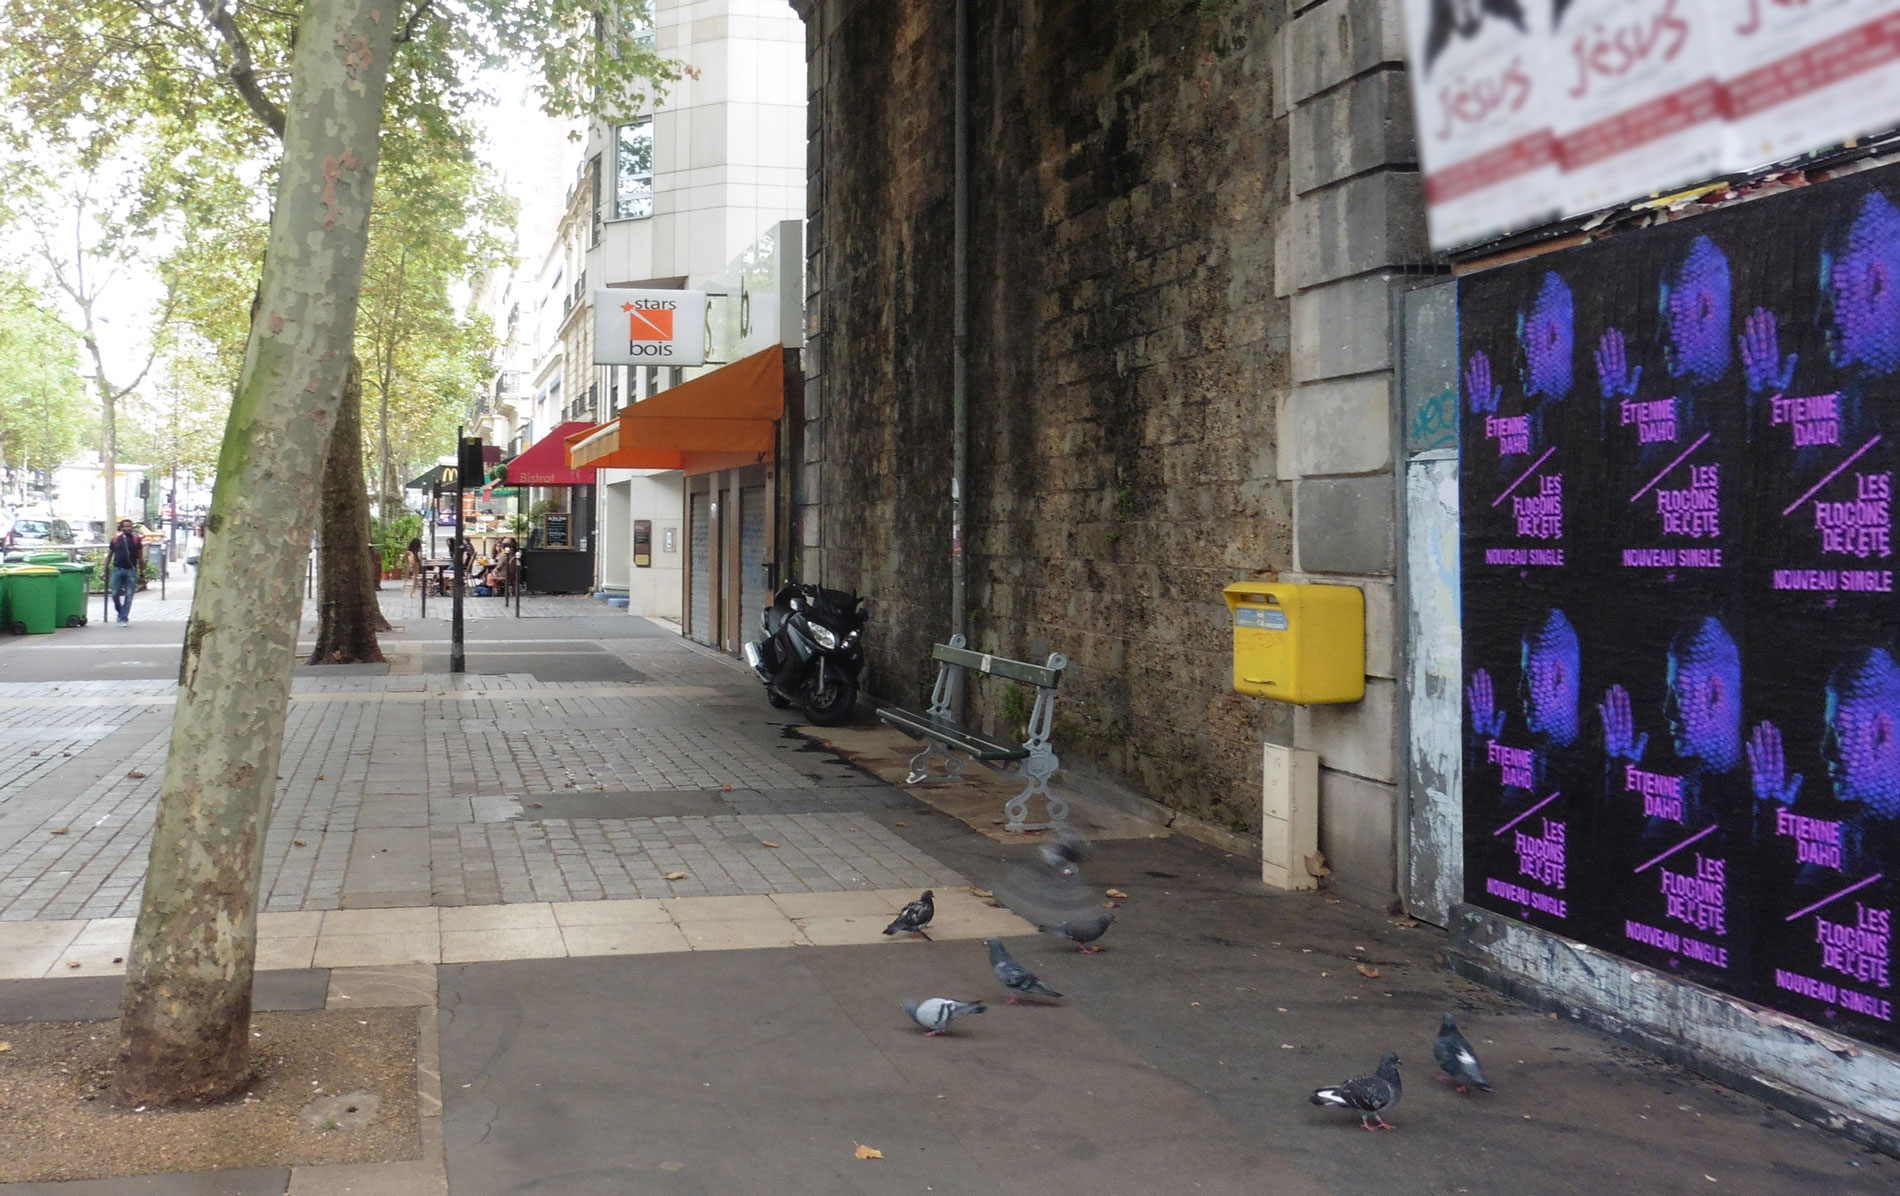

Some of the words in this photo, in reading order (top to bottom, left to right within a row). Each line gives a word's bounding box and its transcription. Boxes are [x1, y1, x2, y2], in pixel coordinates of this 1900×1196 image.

[635, 298, 676, 309] stars
[630, 340, 672, 356] bois
[1499, 436, 1529, 456] DAHO
[1638, 421, 1677, 445] DAHO
[1792, 421, 1841, 449] DAHO
[520, 473, 554, 483] Bistrot
[1539, 473, 1562, 496] LES
[1690, 463, 1720, 489] LES
[1856, 471, 1892, 501] LES
[1513, 496, 1562, 517] FLOCONS
[1656, 488, 1720, 513] FLOCONS
[1815, 501, 1891, 529] FLOCONS
[1486, 549, 1527, 565] NOUVEAU
[1529, 549, 1564, 565] SINGLE
[1623, 549, 1676, 567] NOUVEAU
[1678, 549, 1722, 567] SINGLE
[1773, 570, 1837, 589] NOUVEAU
[1841, 570, 1893, 592] SINGLE
[1501, 765, 1533, 792] DAHO
[1643, 794, 1683, 824] DAHO
[1543, 817, 1566, 845] LES
[1515, 830, 1566, 865] FLOCONS
[1796, 838, 1842, 872] DAHO
[1695, 853, 1726, 886] LES
[1487, 877, 1529, 905] NOUVEAU
[1531, 892, 1566, 918] SINGLE
[1660, 867, 1725, 908] FLOCONS
[1856, 901, 1891, 937] LES
[1626, 920, 1679, 952] NOUVEAU
[1682, 937, 1727, 968] SINGLE
[1815, 915, 1890, 960] FLOCONS
[1776, 968, 1836, 1003] NOUVEAU
[1840, 988, 1891, 1021] SINGLE
